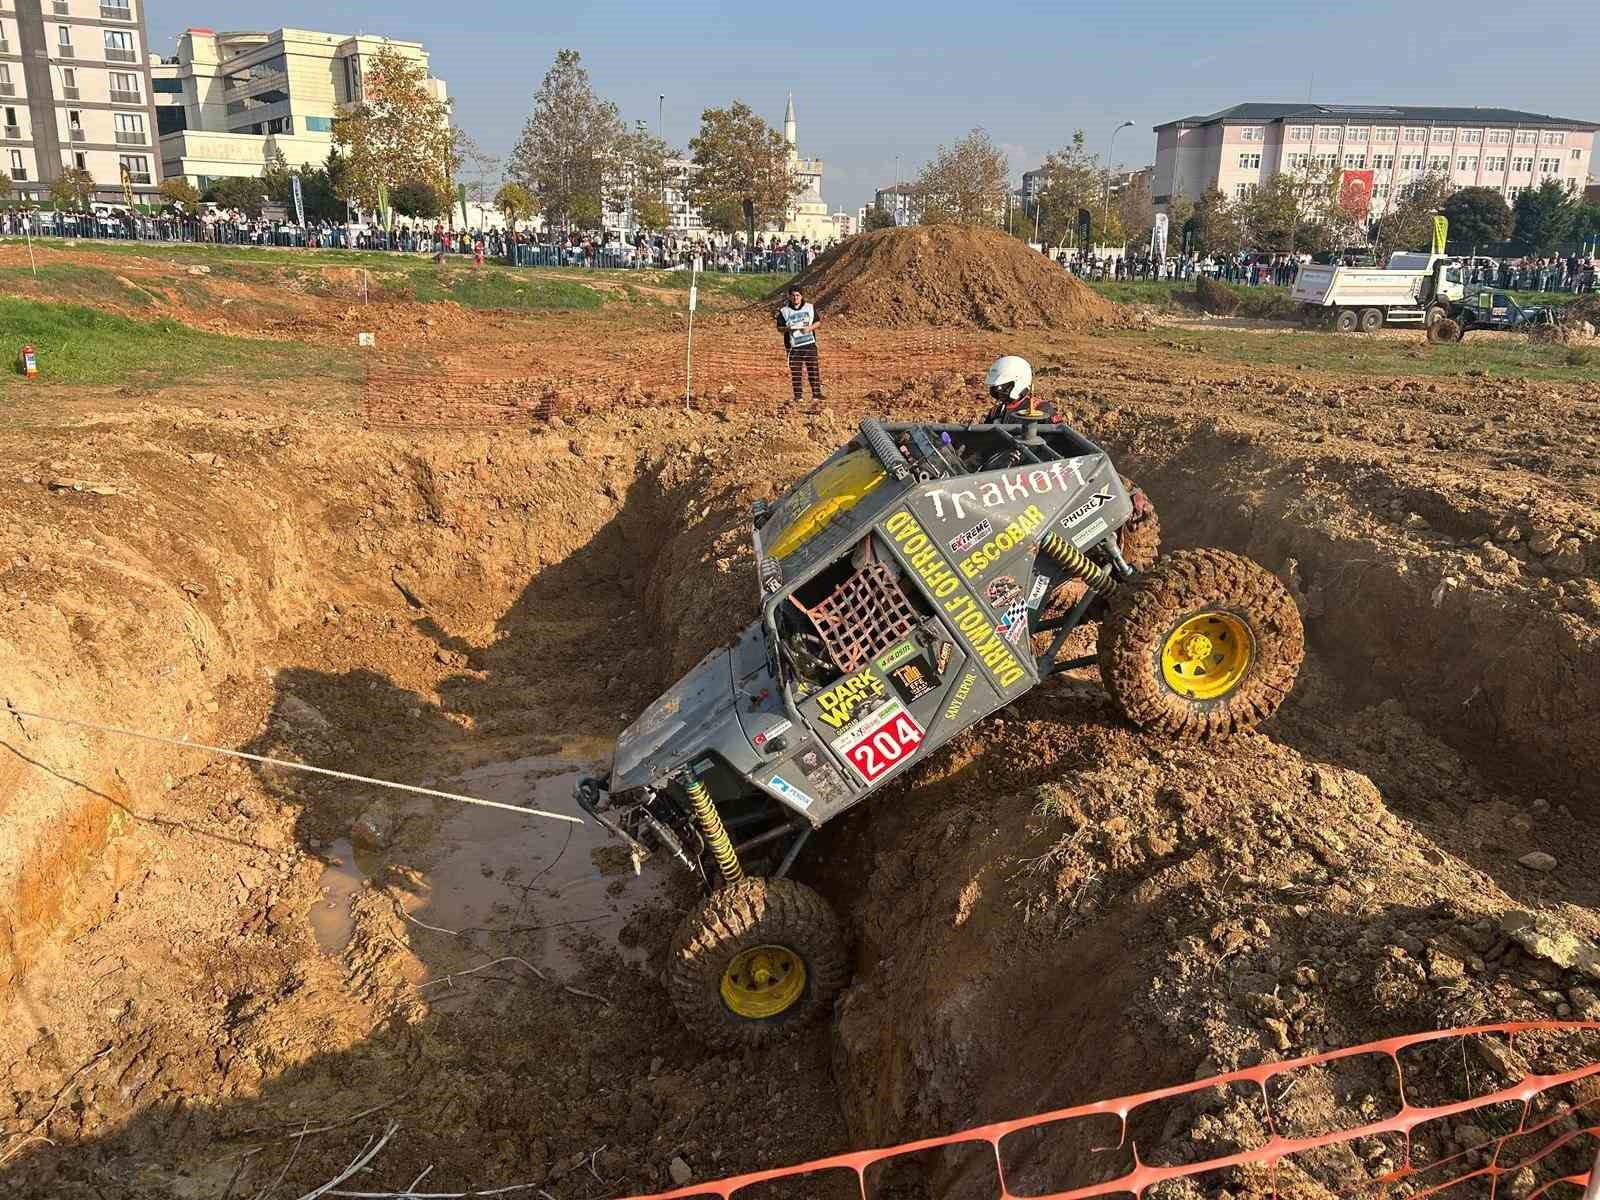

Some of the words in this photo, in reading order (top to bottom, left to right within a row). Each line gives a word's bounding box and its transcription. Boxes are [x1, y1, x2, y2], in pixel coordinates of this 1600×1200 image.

[924, 457, 1086, 520] Trakoff
[884, 510, 961, 598] OFFROAD
[959, 504, 1046, 579] ESCOBAR
[944, 594, 1025, 688] DARKWOLF
[816, 668, 878, 711] DARK
[854, 717, 922, 776] 204
